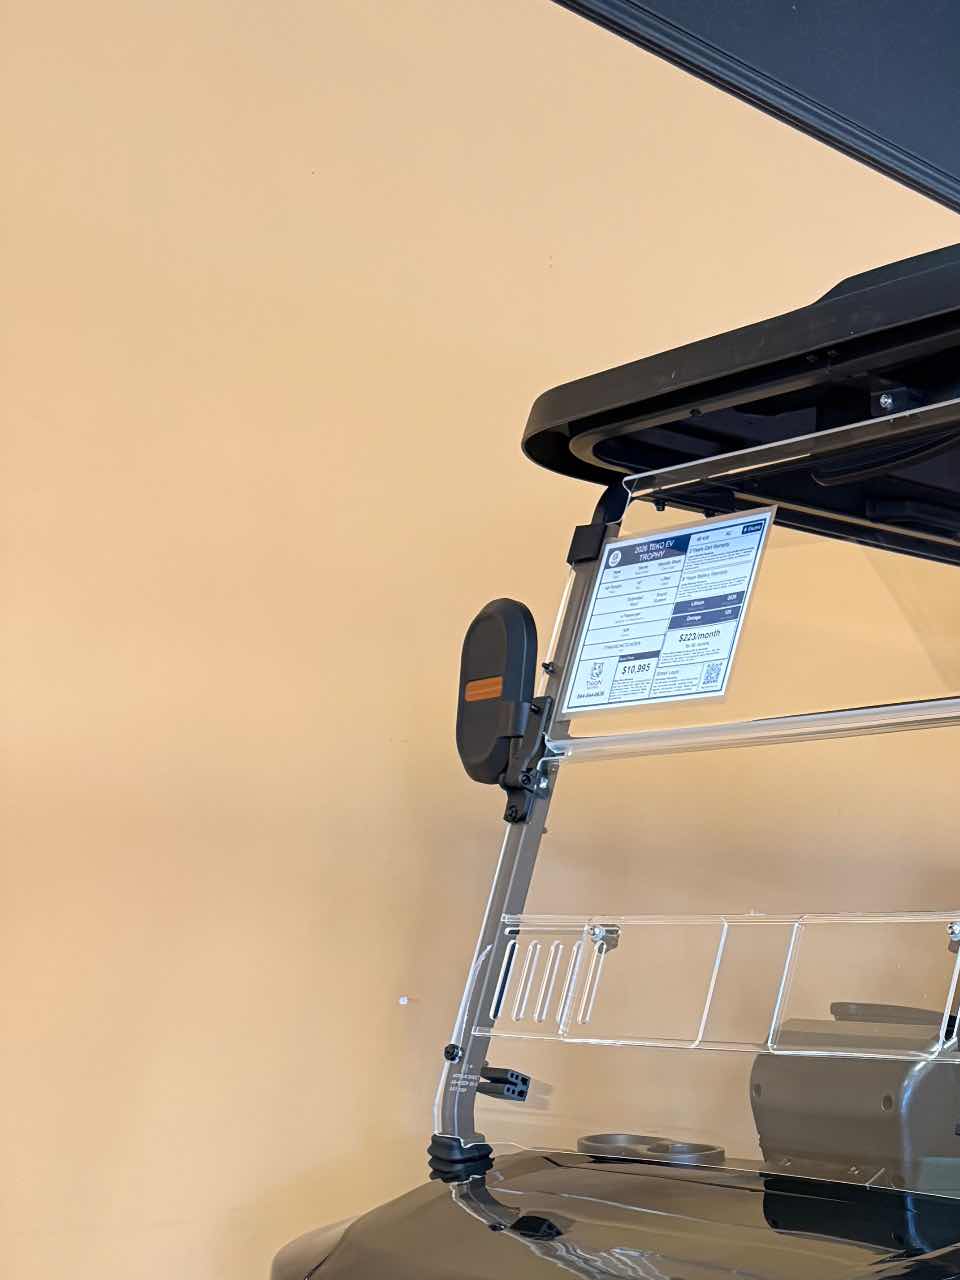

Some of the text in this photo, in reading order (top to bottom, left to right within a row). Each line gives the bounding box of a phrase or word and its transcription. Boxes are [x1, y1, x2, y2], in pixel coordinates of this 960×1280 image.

[649, 542, 665, 551] TEKO
[666, 540, 675, 548] EV
[639, 550, 666, 561] TROPHY
[679, 629, 721, 643] $223/month
[622, 663, 651, 675] $10,995
